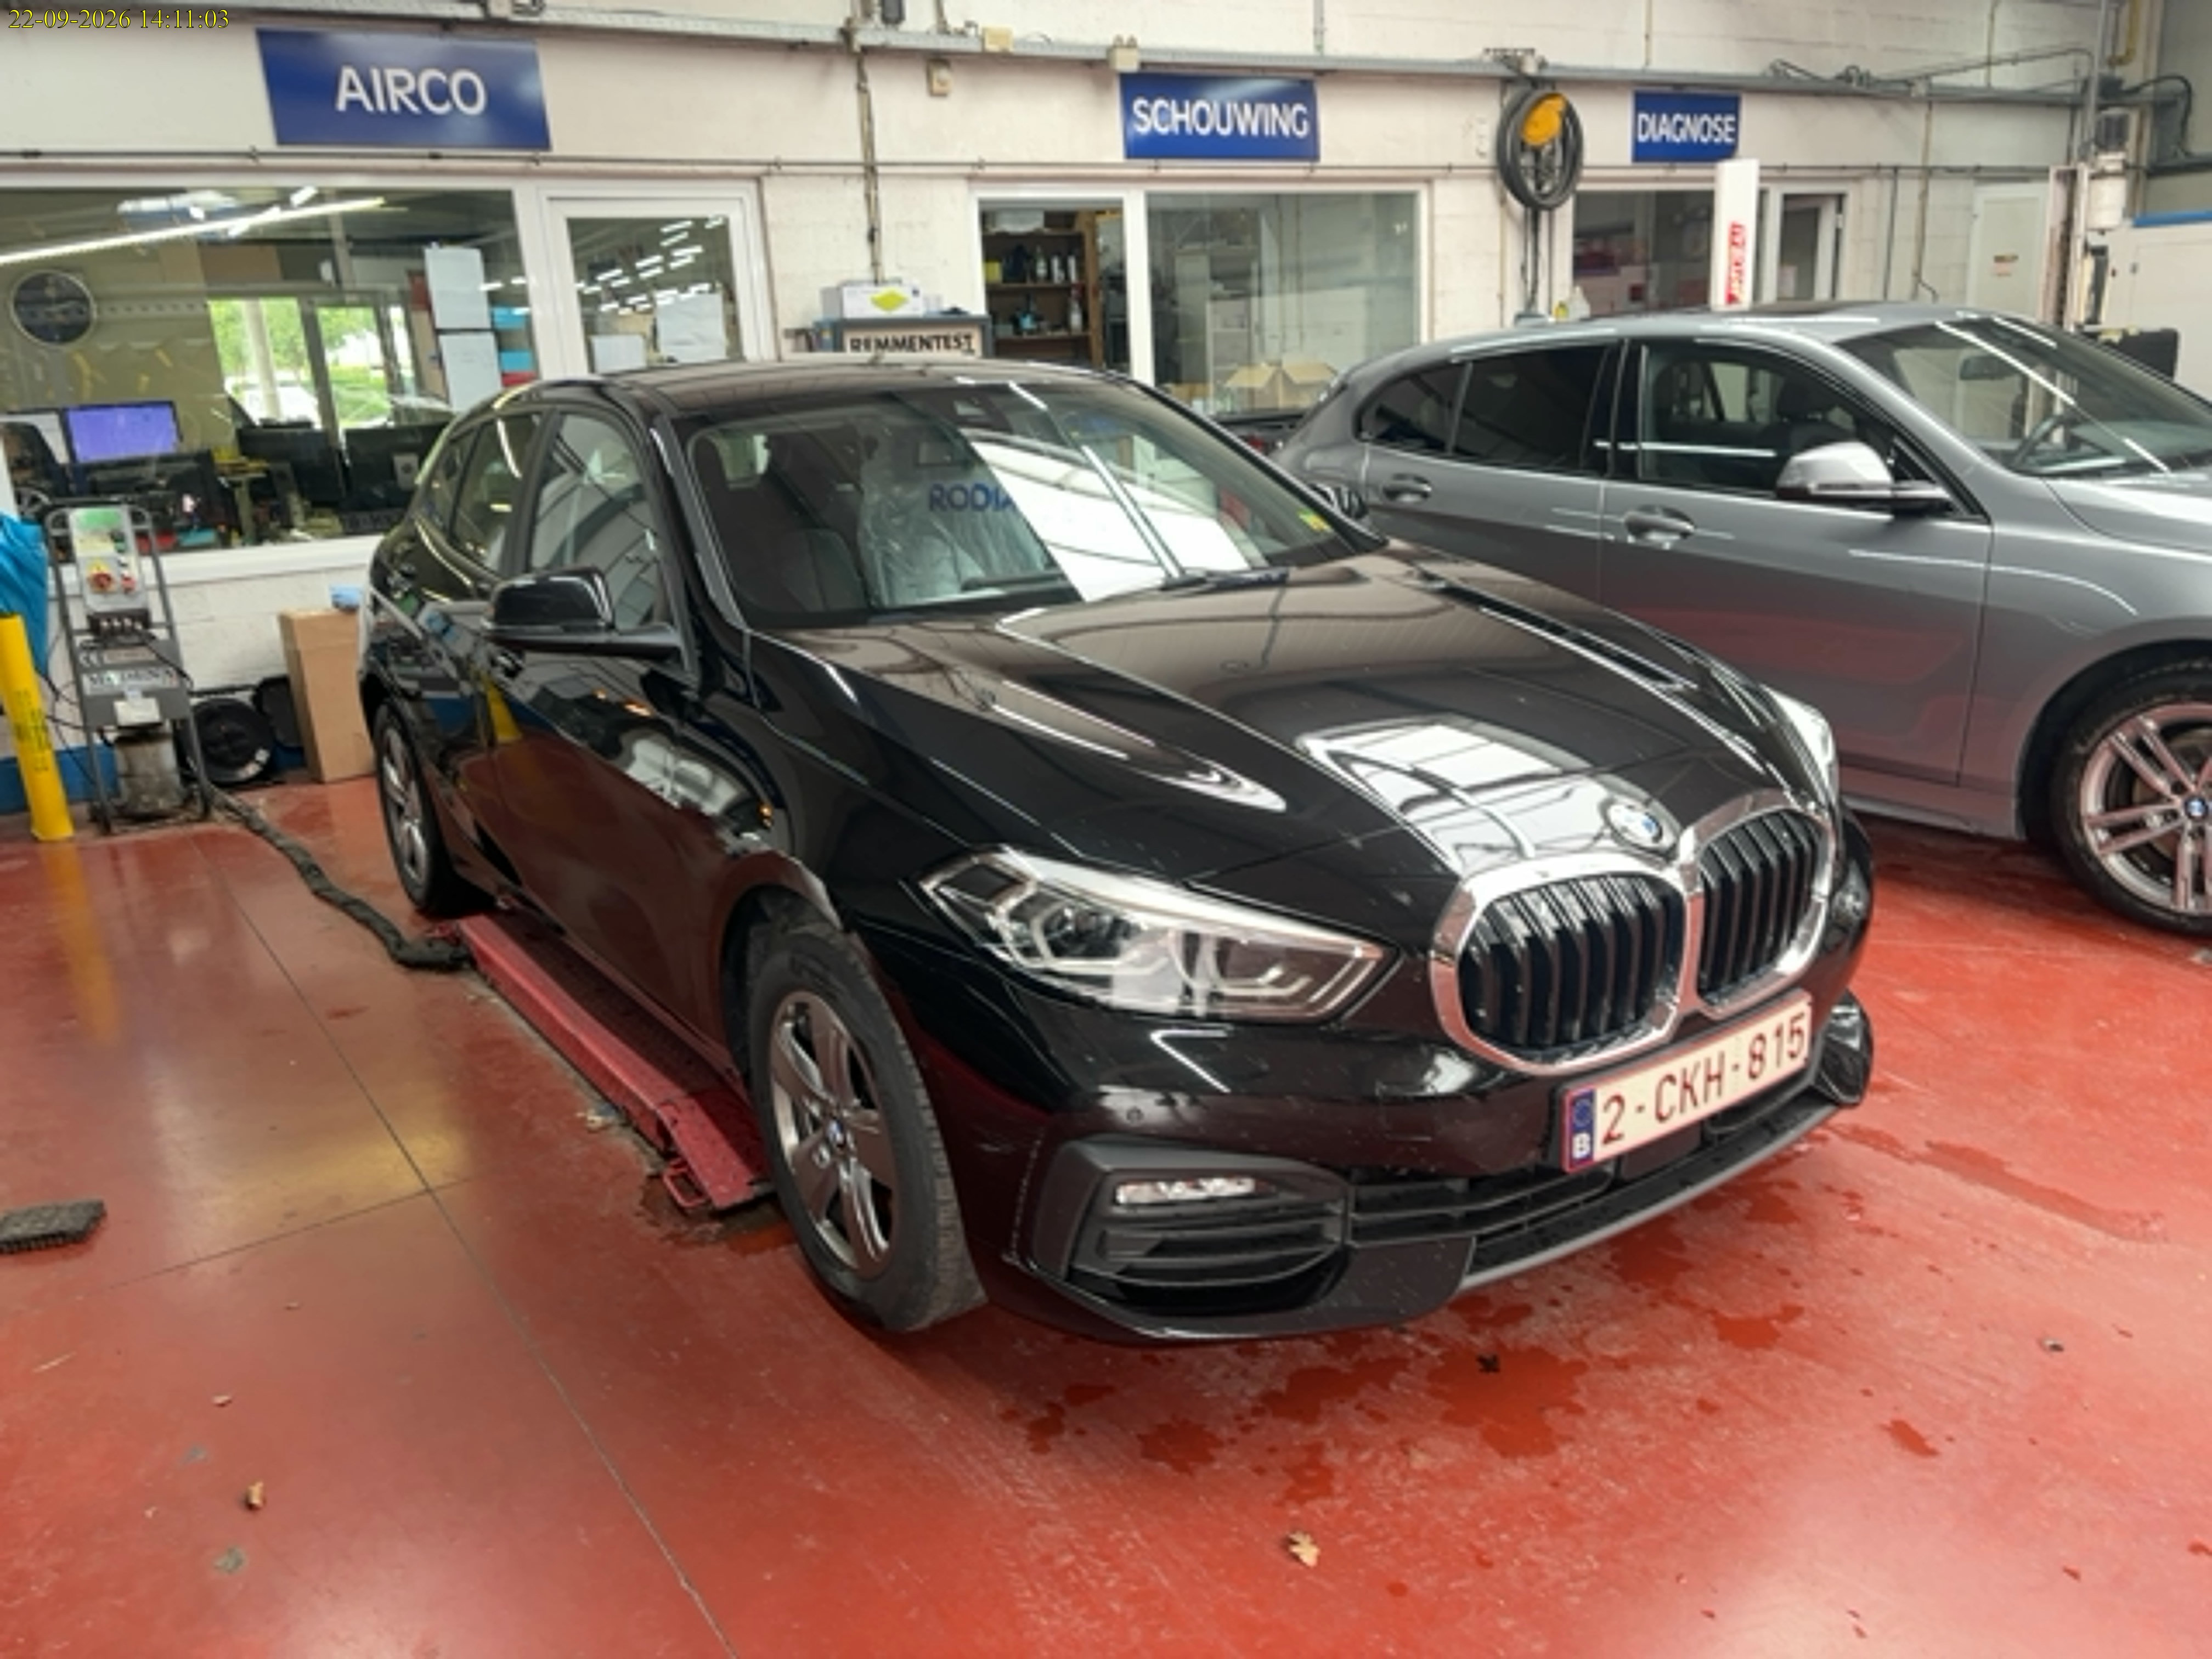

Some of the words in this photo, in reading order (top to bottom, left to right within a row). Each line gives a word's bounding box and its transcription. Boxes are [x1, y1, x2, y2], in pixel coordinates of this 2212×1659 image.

[336, 66, 487, 115] AIRCO
[1133, 97, 1309, 139] SCHOUWING
[1637, 113, 1736, 144] DIAGNOSE
[1601, 1011, 1807, 1146] 2-CKH-815
[1572, 1129, 1590, 1158] B
